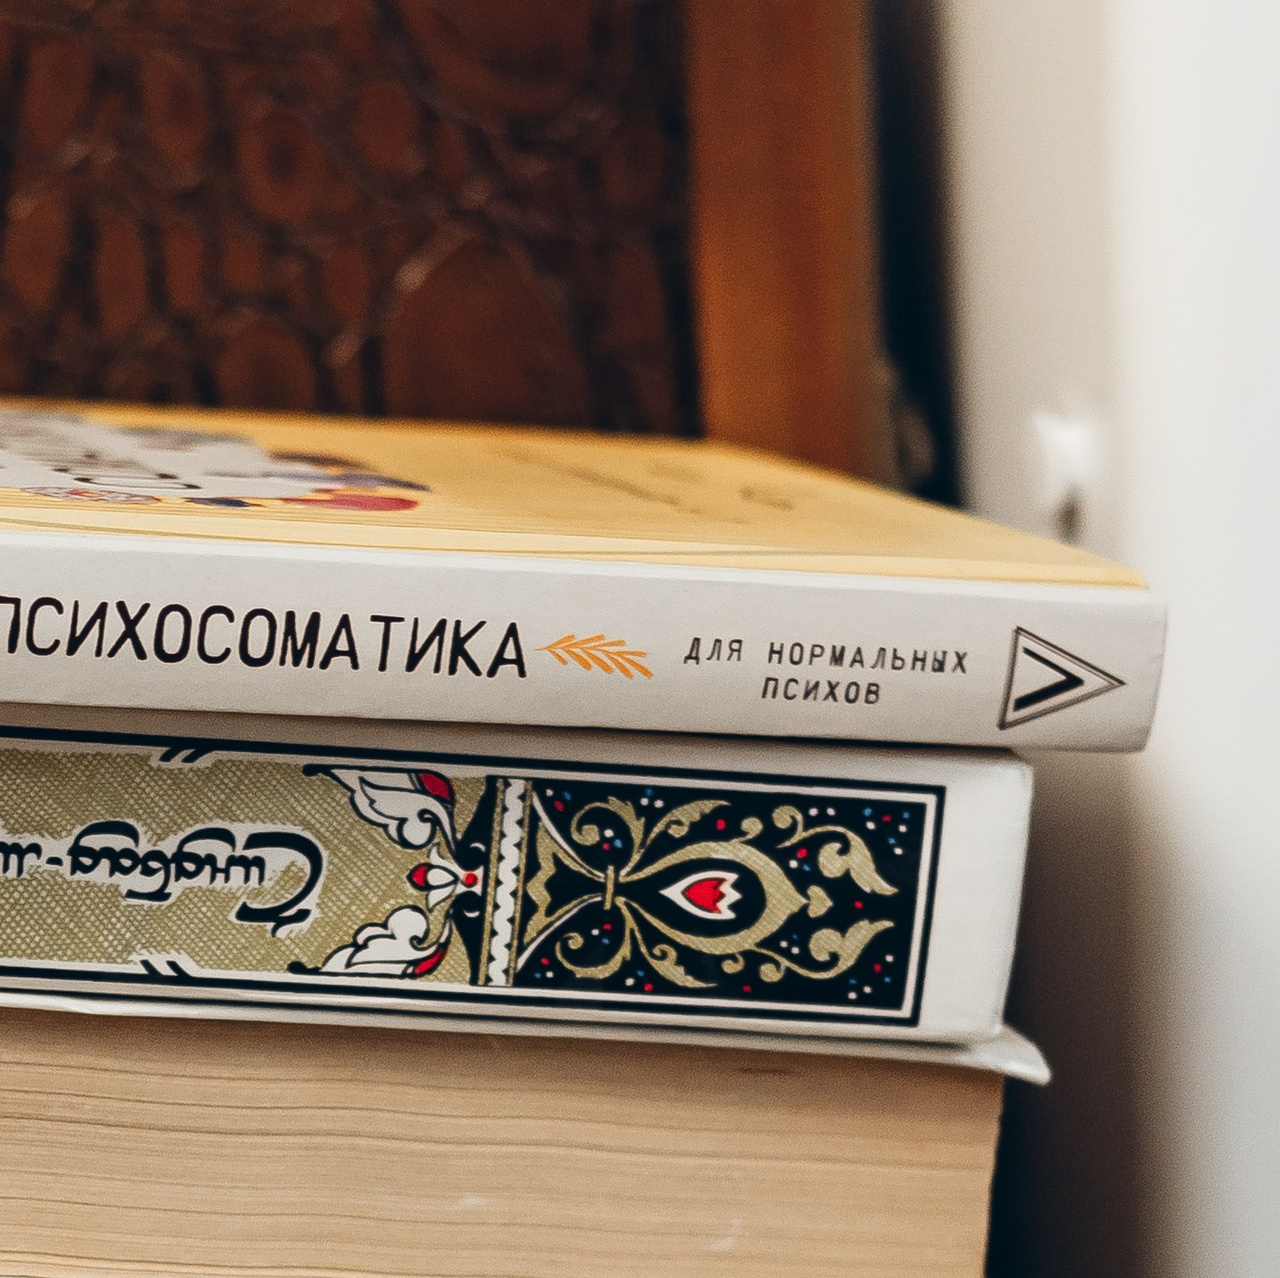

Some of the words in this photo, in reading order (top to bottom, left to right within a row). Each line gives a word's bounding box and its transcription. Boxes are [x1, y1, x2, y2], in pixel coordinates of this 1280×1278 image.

[682, 636, 744, 665] ДЛЯ
[767, 640, 970, 675] НОРМАЛЬНЫХ
[760, 676, 882, 706] ПСИХОВ
